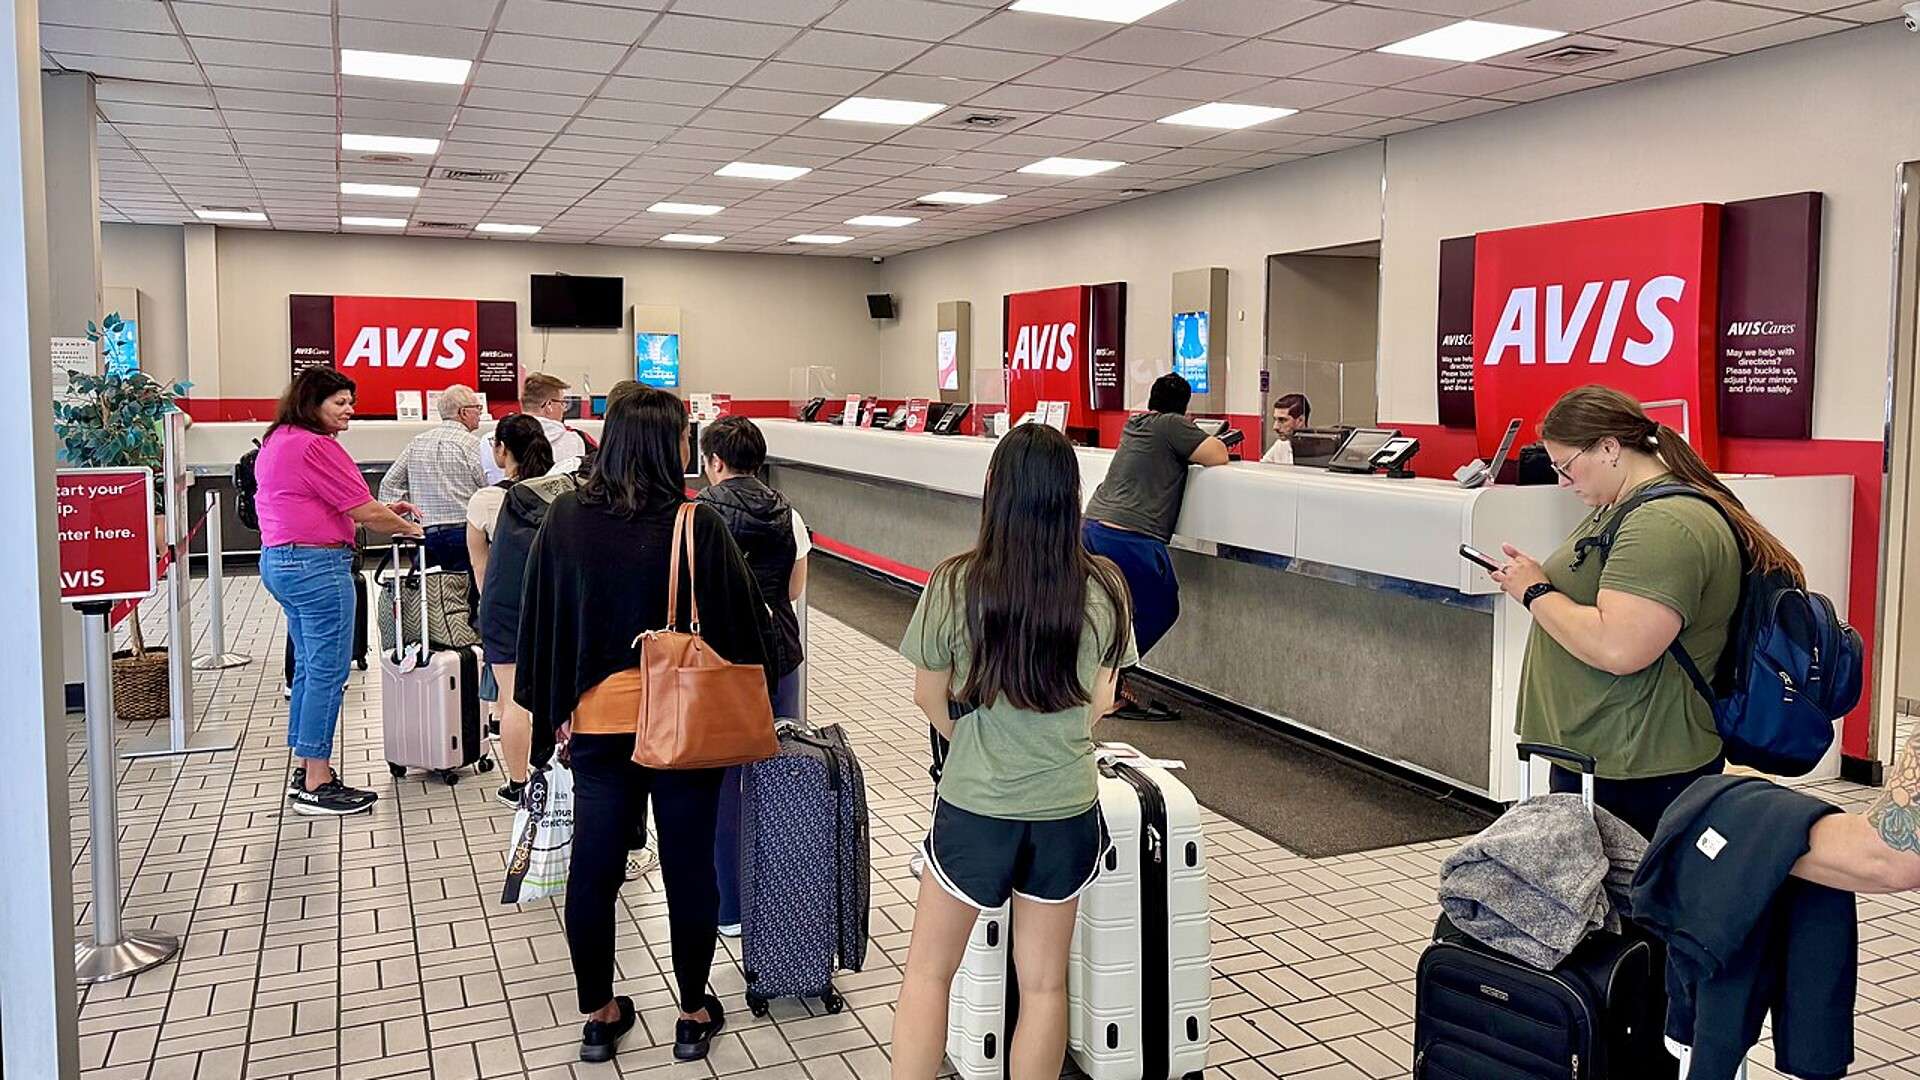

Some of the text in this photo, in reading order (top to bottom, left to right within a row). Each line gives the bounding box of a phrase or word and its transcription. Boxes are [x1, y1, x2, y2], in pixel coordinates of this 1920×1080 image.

[1483, 275, 1686, 366] AVIS
[342, 326, 471, 369] AVIS
[1011, 322, 1076, 372] AVIS
[1726, 348, 1743, 358] May
[1758, 348, 1776, 357] help
[1777, 347, 1795, 356] with
[1738, 357, 1782, 366] directions?
[1726, 366, 1796, 376] Please buckle up,
[1723, 377, 1747, 385] adjust
[1748, 377, 1767, 386] your
[1728, 385, 1793, 395] and drive safely.
[57, 484, 125, 499] art your
[57, 502, 78, 517] ip.
[57, 526, 136, 541] nter here.
[298, 791, 319, 803] HOKA
